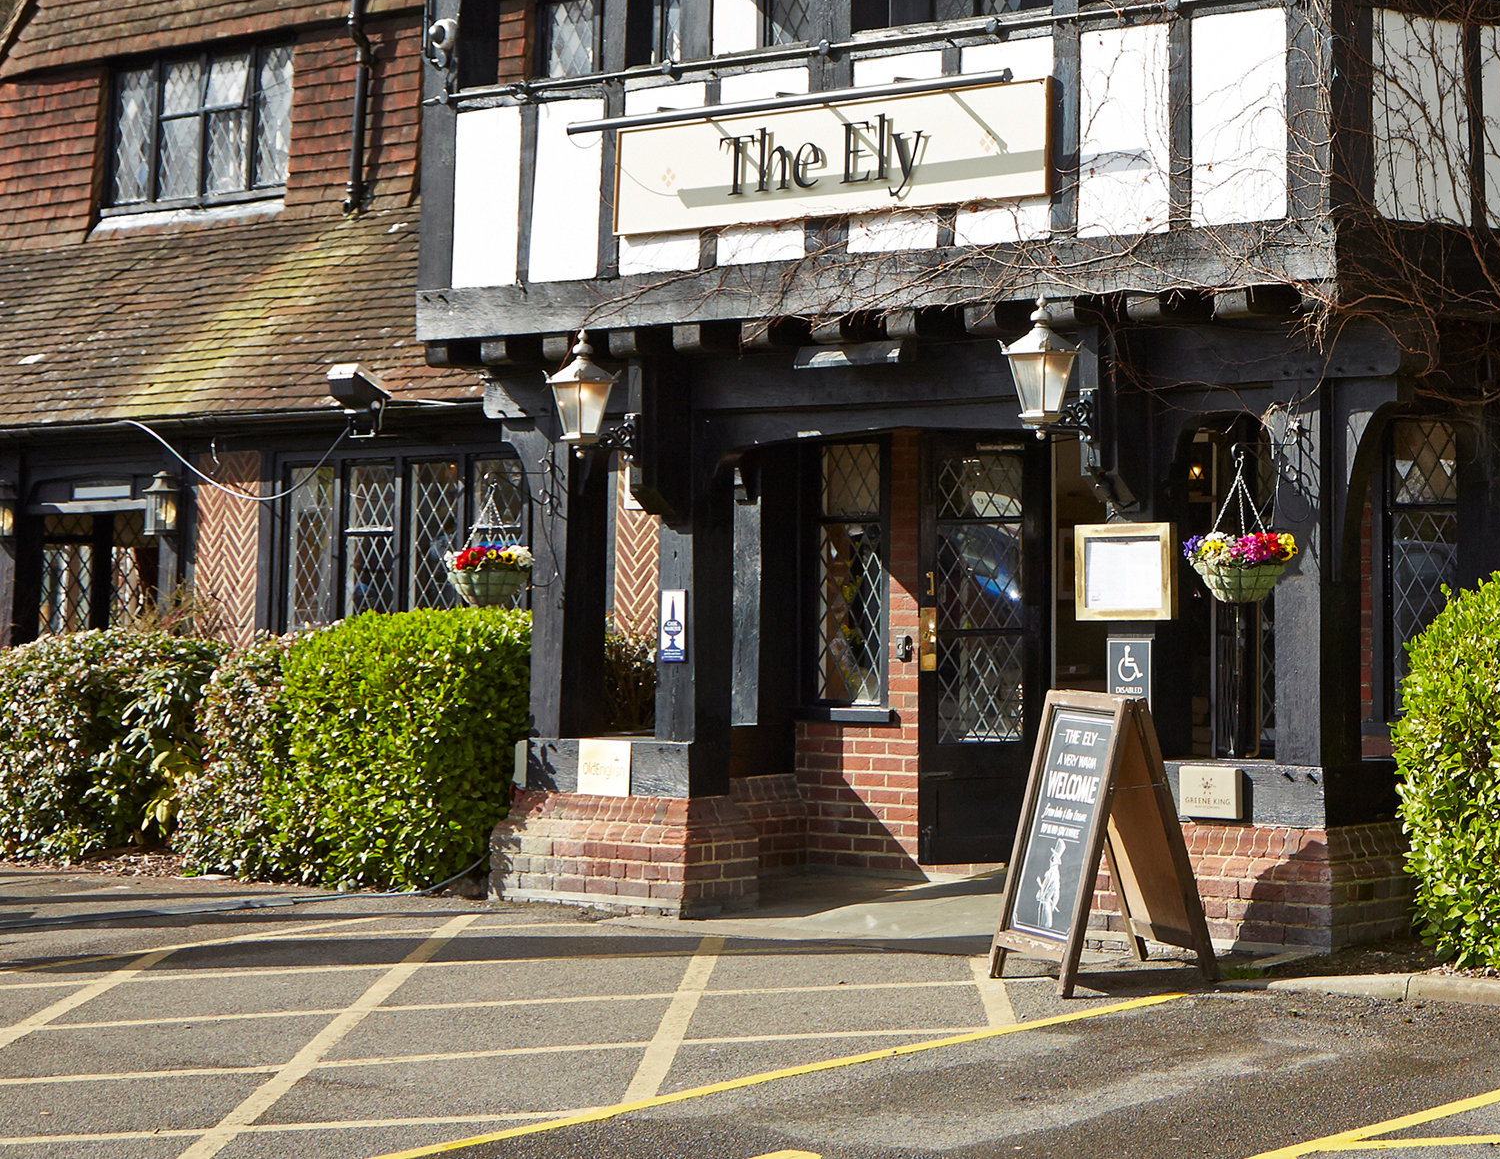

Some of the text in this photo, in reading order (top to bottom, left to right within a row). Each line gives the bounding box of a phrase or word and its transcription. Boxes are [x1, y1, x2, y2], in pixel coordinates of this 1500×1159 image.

[720, 113, 925, 198] The Ely
[1115, 686, 1143, 694] DISABLED
[1064, 729, 1099, 747] THE ELY
[1057, 752, 1064, 765] A
[1064, 753, 1079, 767] VERY
[1047, 770, 1100, 805] WELCOME
[1185, 796, 1231, 806] GREENE KING
